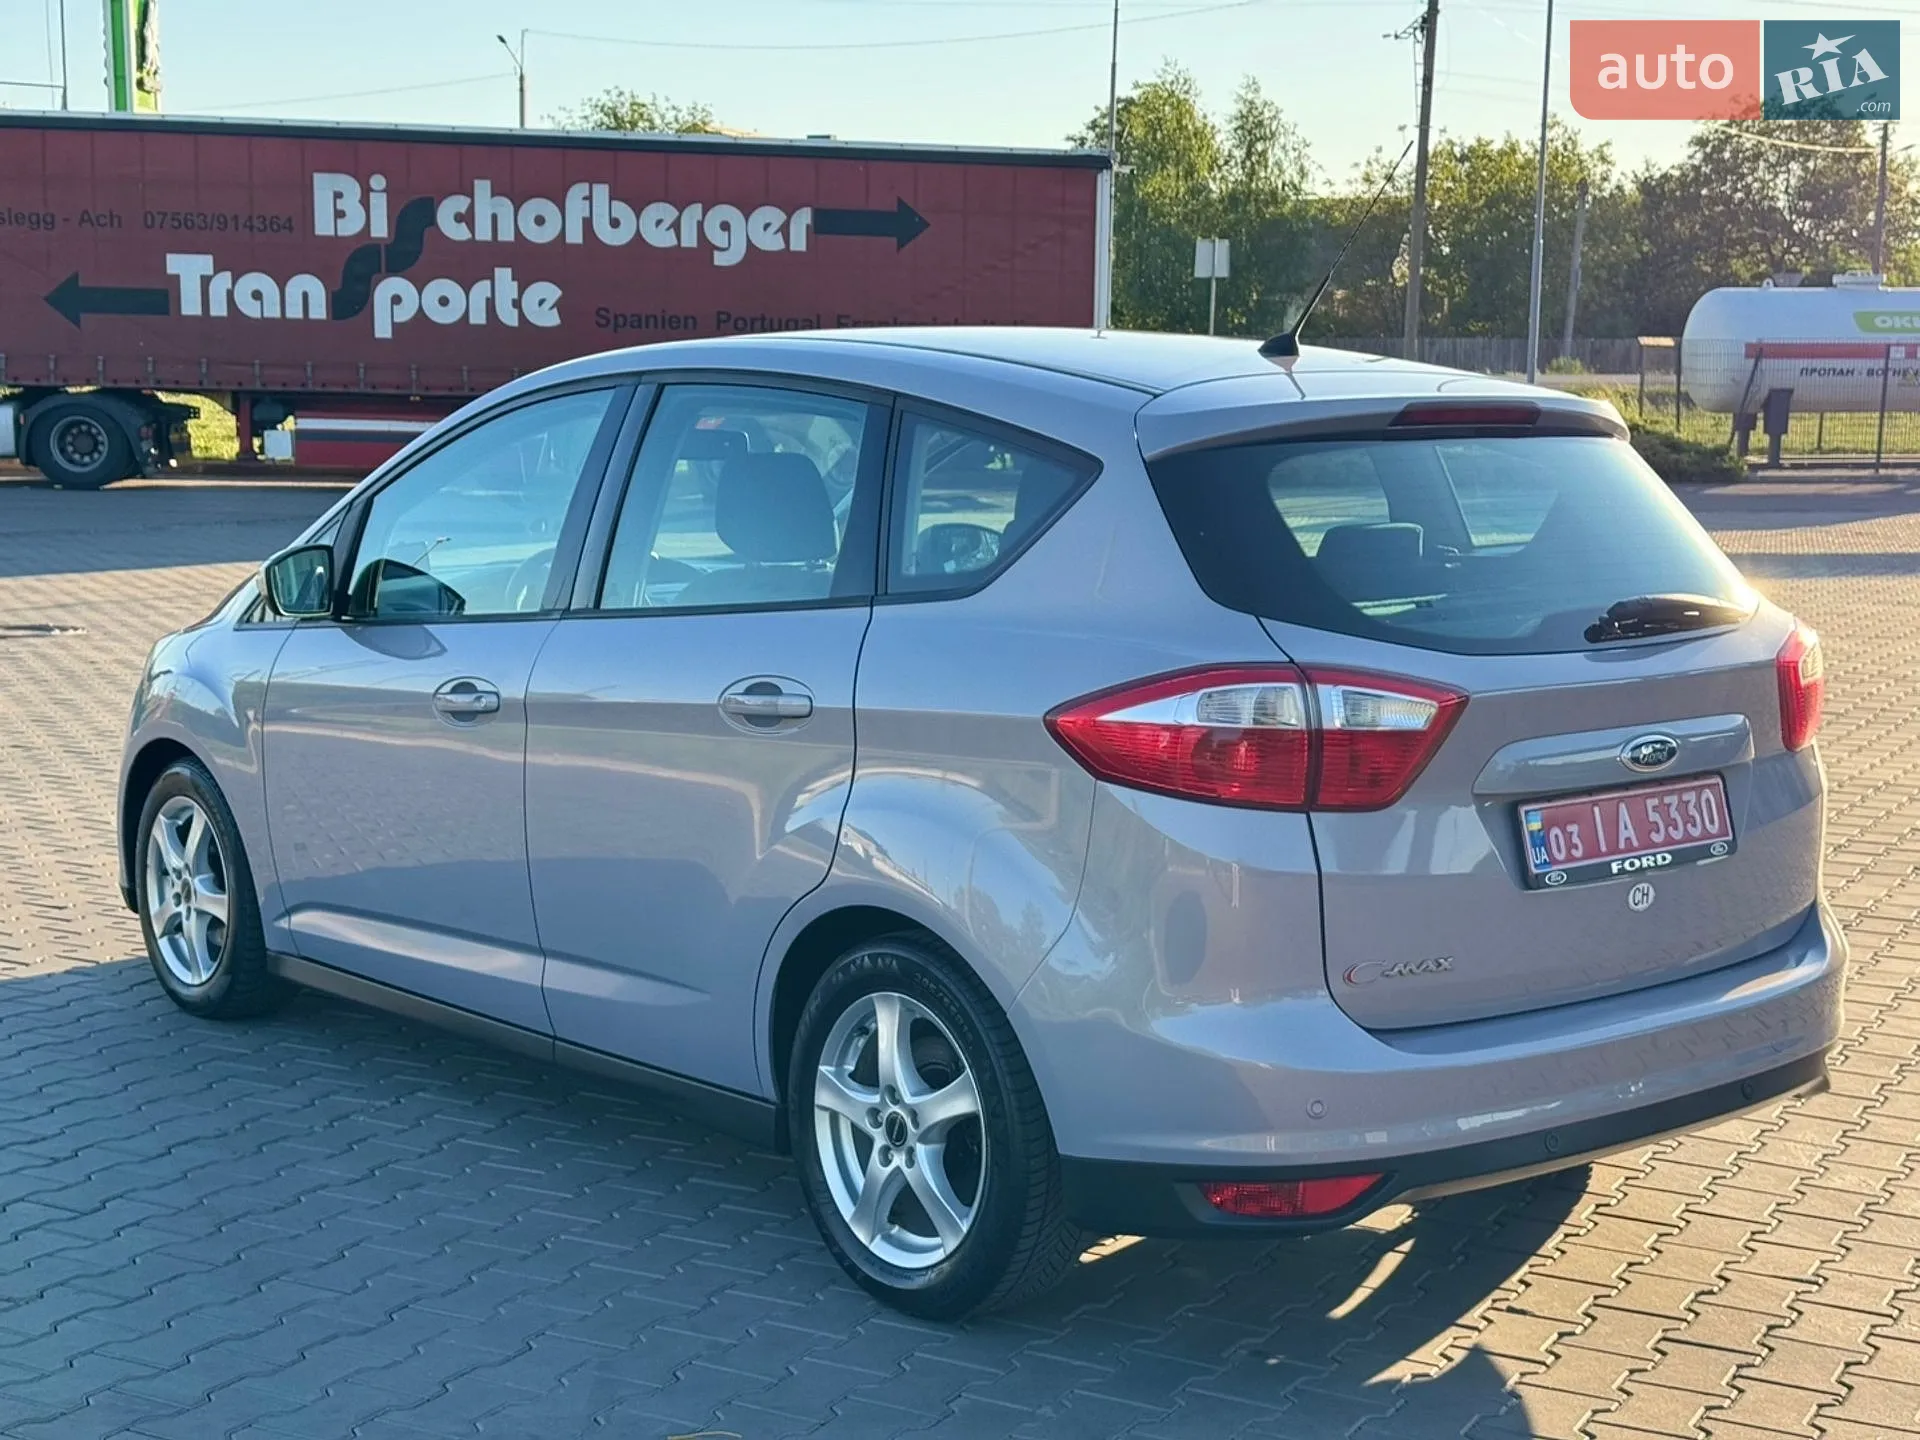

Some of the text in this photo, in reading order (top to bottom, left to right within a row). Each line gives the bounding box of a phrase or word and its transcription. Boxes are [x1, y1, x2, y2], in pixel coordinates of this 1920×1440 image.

[78, 209, 123, 229] Ach
[143, 211, 294, 233] 07563/914364
[595, 307, 698, 333] Spanien
[1800, 367, 1855, 377] ПРОПАН
[1550, 824, 1583, 861] 03
[1646, 789, 1719, 844] 5330
[1532, 847, 1549, 864] UA
[1611, 853, 1672, 875] FORD
[1632, 887, 1650, 906] CH
